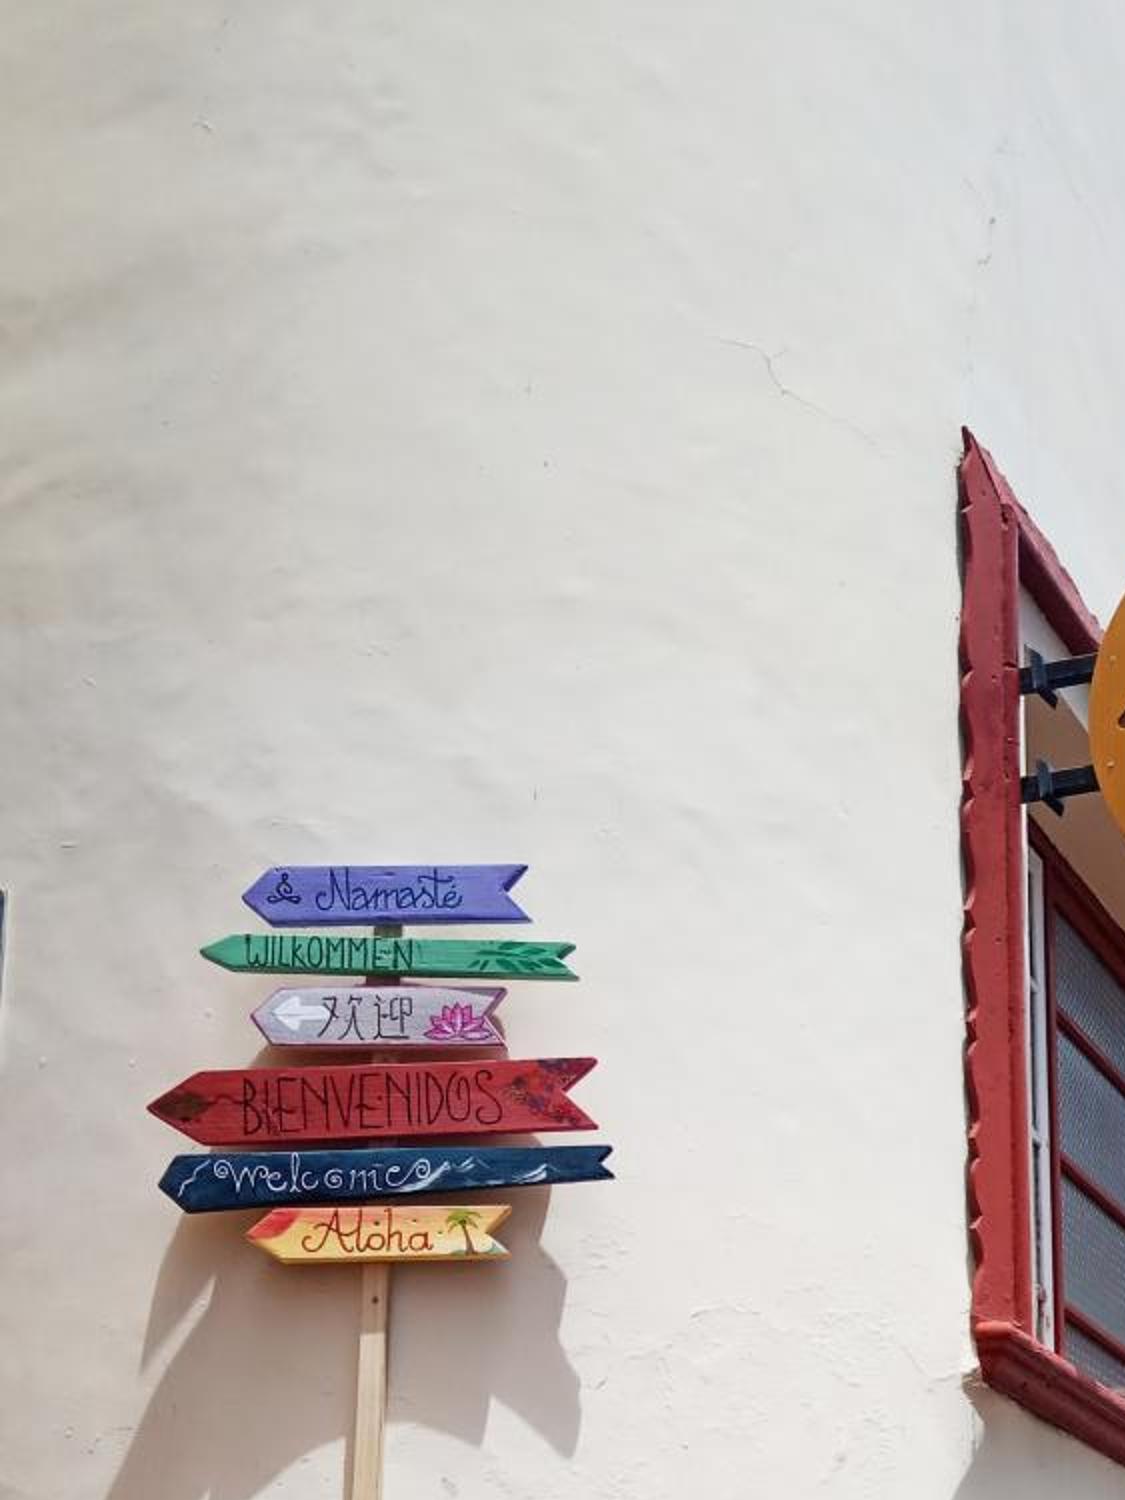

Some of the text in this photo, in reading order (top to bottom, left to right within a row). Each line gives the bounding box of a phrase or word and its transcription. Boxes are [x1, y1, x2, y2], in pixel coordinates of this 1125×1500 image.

[244, 935, 414, 970] WILKOMMEN
[316, 995, 414, 1040] 欢迎
[241, 1069, 504, 1137] BIENVENIDOS
[213, 1151, 430, 1195] Welcome
[301, 1207, 436, 1254] Aloha
